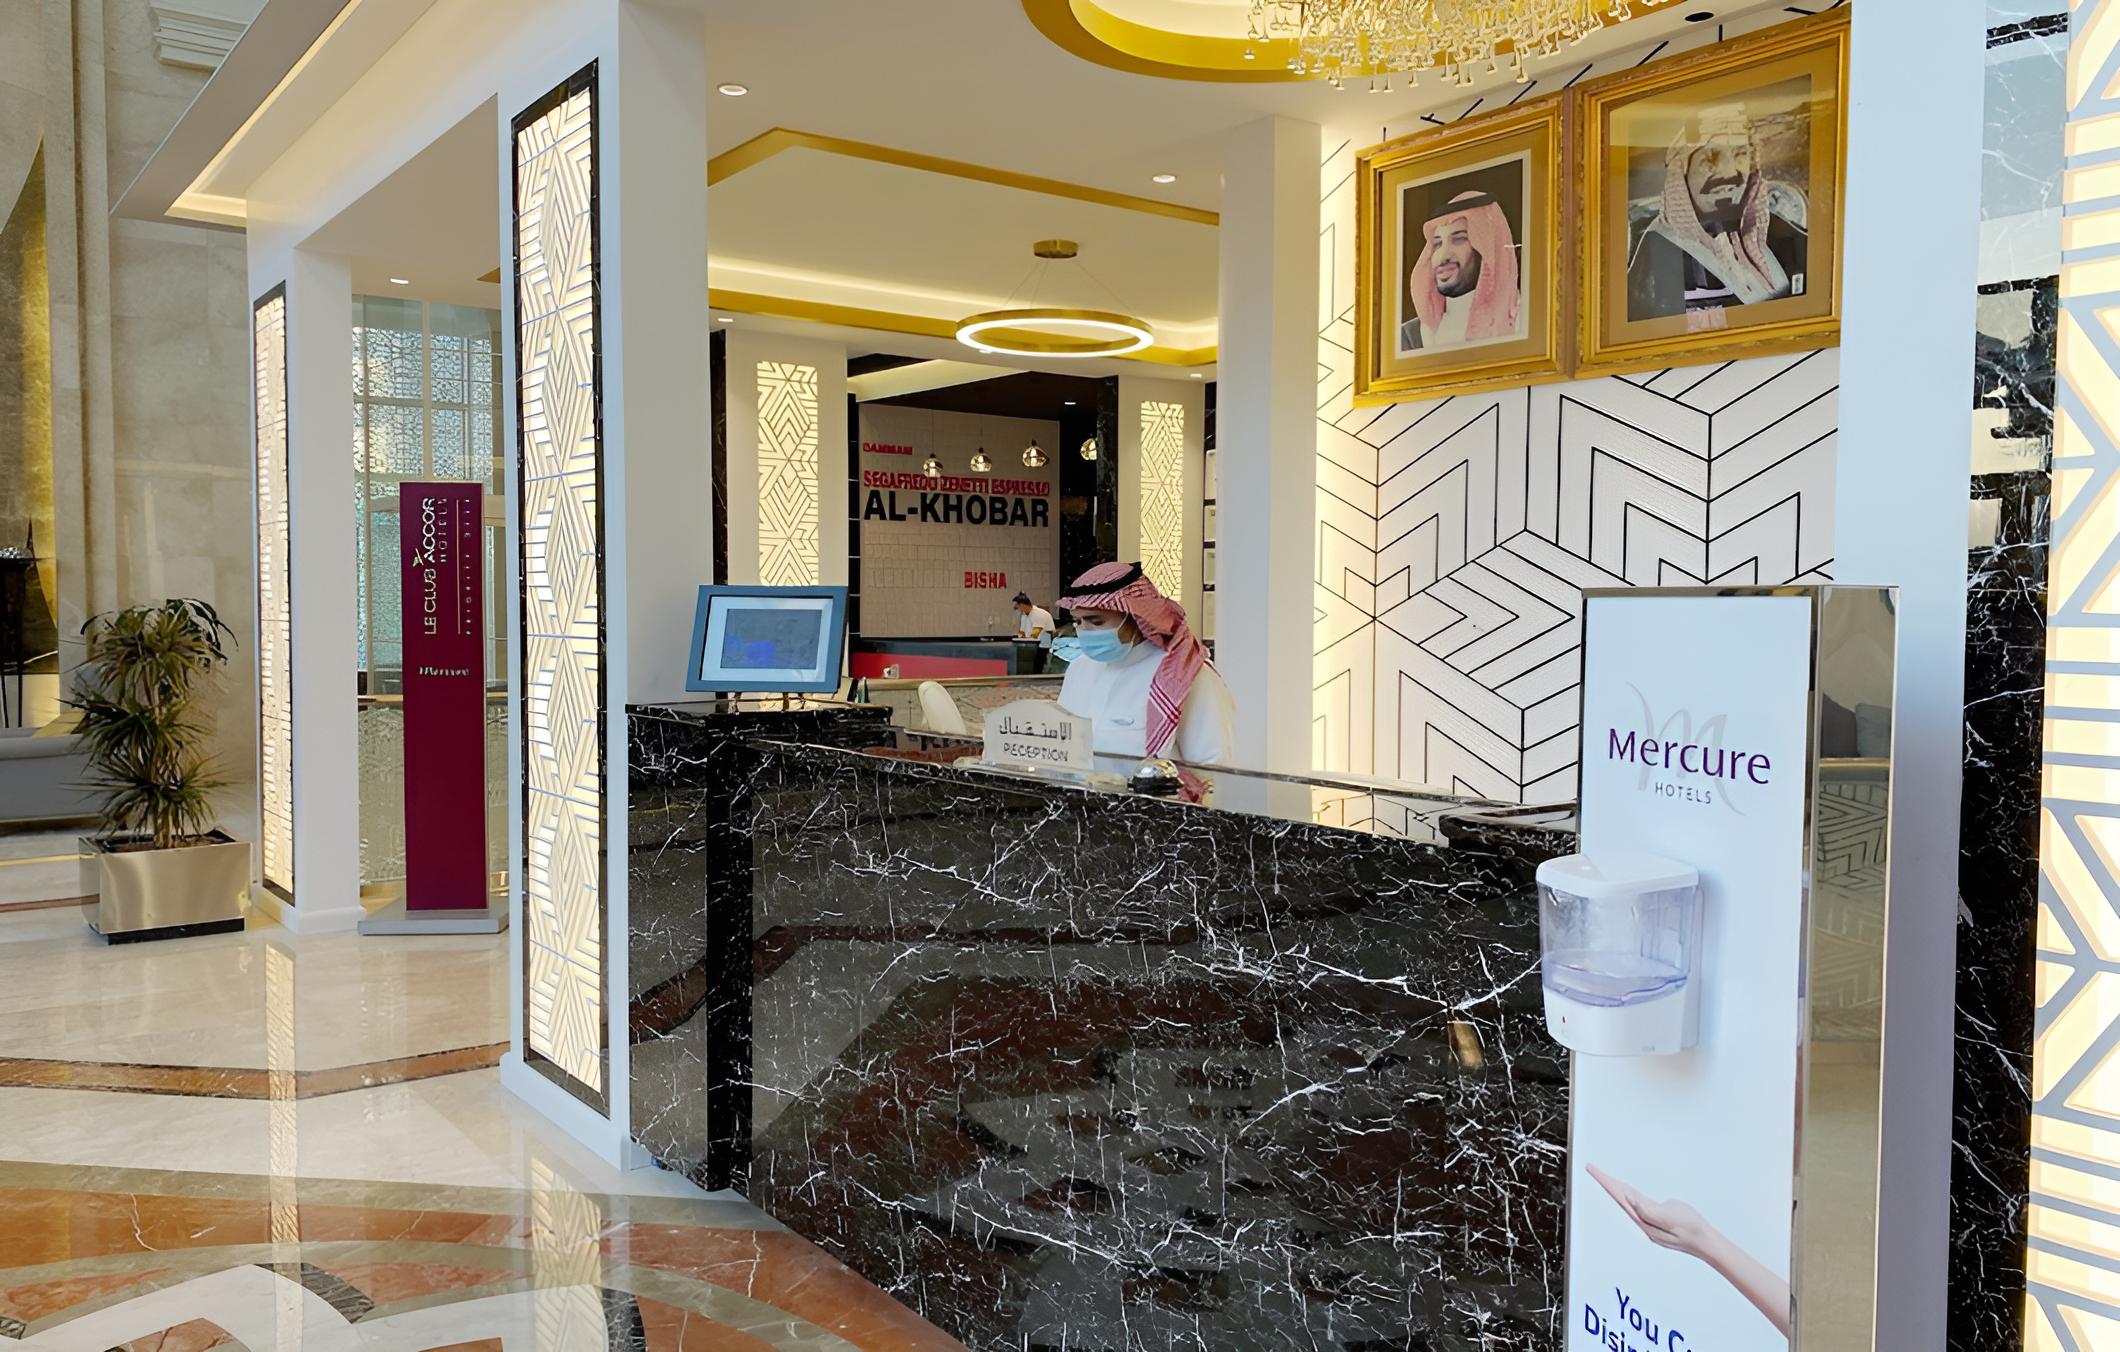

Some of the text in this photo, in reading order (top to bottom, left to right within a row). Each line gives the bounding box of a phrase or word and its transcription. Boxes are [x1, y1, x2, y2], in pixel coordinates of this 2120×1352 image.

[864, 490, 1049, 527] AL-KHOBAR
[422, 497, 437, 635] LE CLUB ACCOR
[964, 571, 1007, 589] BISHA
[1608, 728, 1771, 785] Mercure
[1655, 782, 1711, 804] HOTELS
[1616, 1287, 1692, 1352] You C
